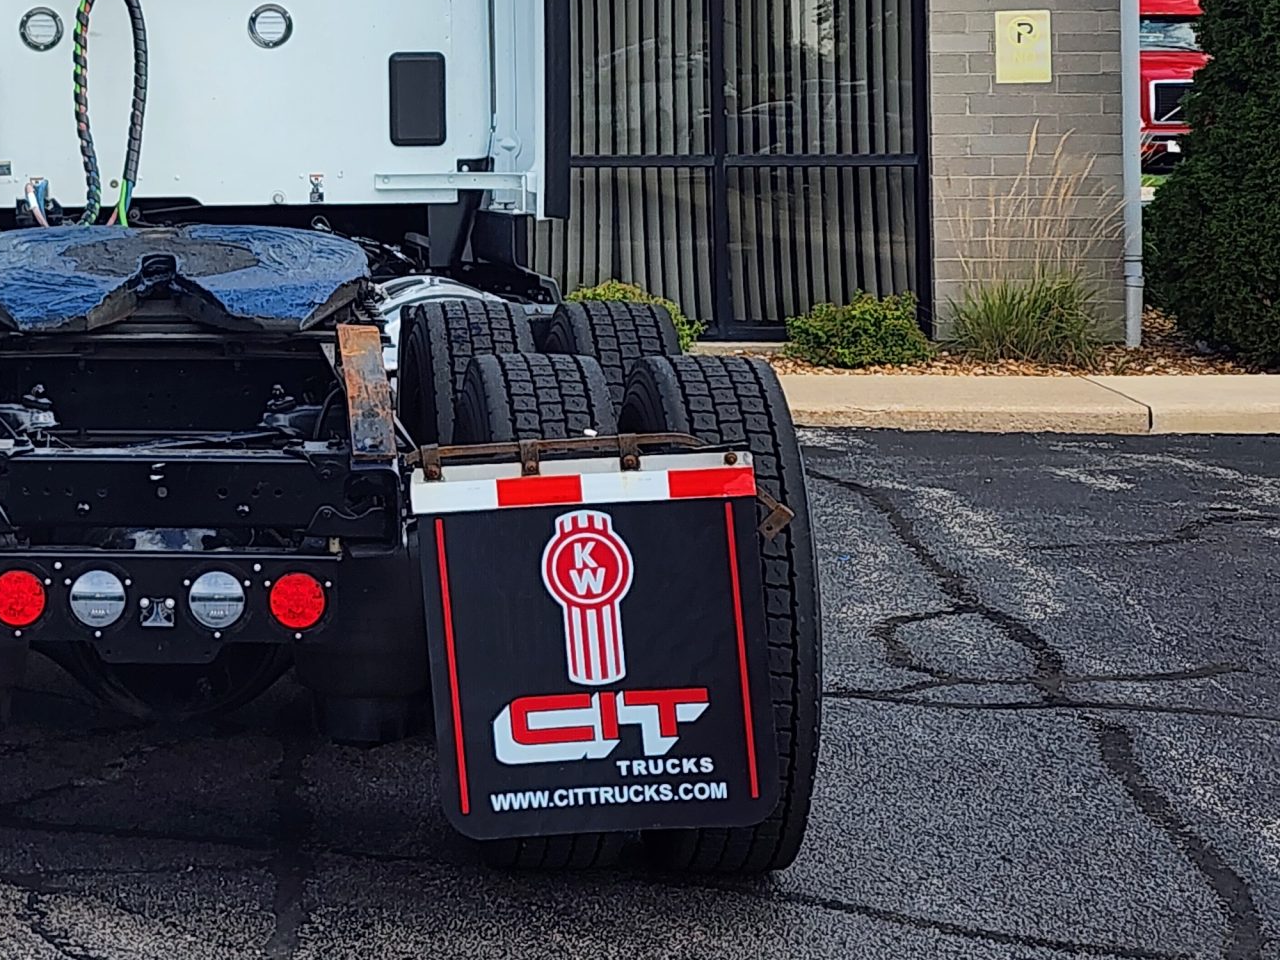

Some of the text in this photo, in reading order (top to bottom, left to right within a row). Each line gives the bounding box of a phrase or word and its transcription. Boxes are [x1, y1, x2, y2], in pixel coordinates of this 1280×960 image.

[574, 541, 598, 568] K
[569, 567, 606, 596] W
[493, 688, 710, 765] CIT
[616, 757, 715, 776] TRUCKS
[490, 782, 728, 812] WWW.CITTRUCKS.COM
